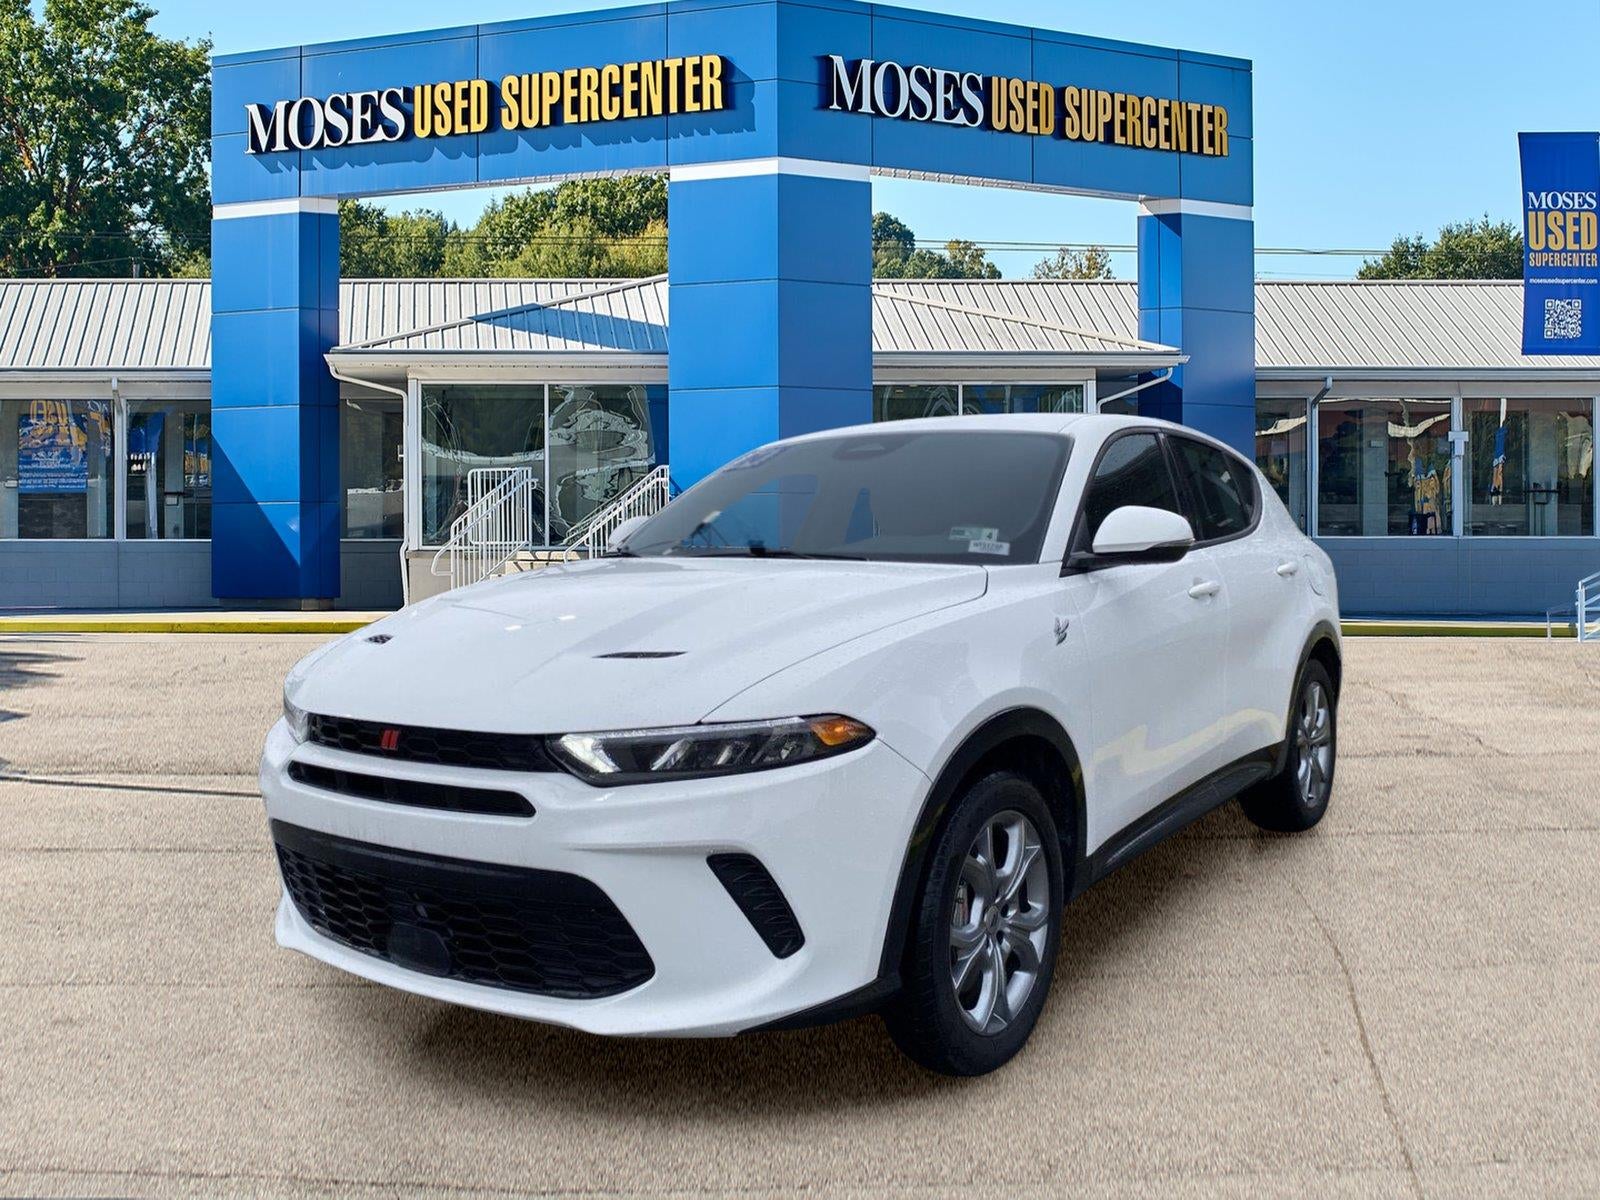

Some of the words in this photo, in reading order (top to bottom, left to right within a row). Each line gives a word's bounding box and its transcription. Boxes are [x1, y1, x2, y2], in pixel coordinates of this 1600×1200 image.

[245, 88, 408, 154] MOSES
[413, 79, 489, 138] USED
[501, 55, 724, 131] SUPERCENTER
[829, 54, 984, 128] MOSES
[991, 76, 1055, 135] USED
[1065, 86, 1230, 156] SUPERCENTER
[1527, 191, 1597, 209] MOSES
[1528, 211, 1598, 250] USED
[1529, 252, 1598, 267] SUPERCENTER
